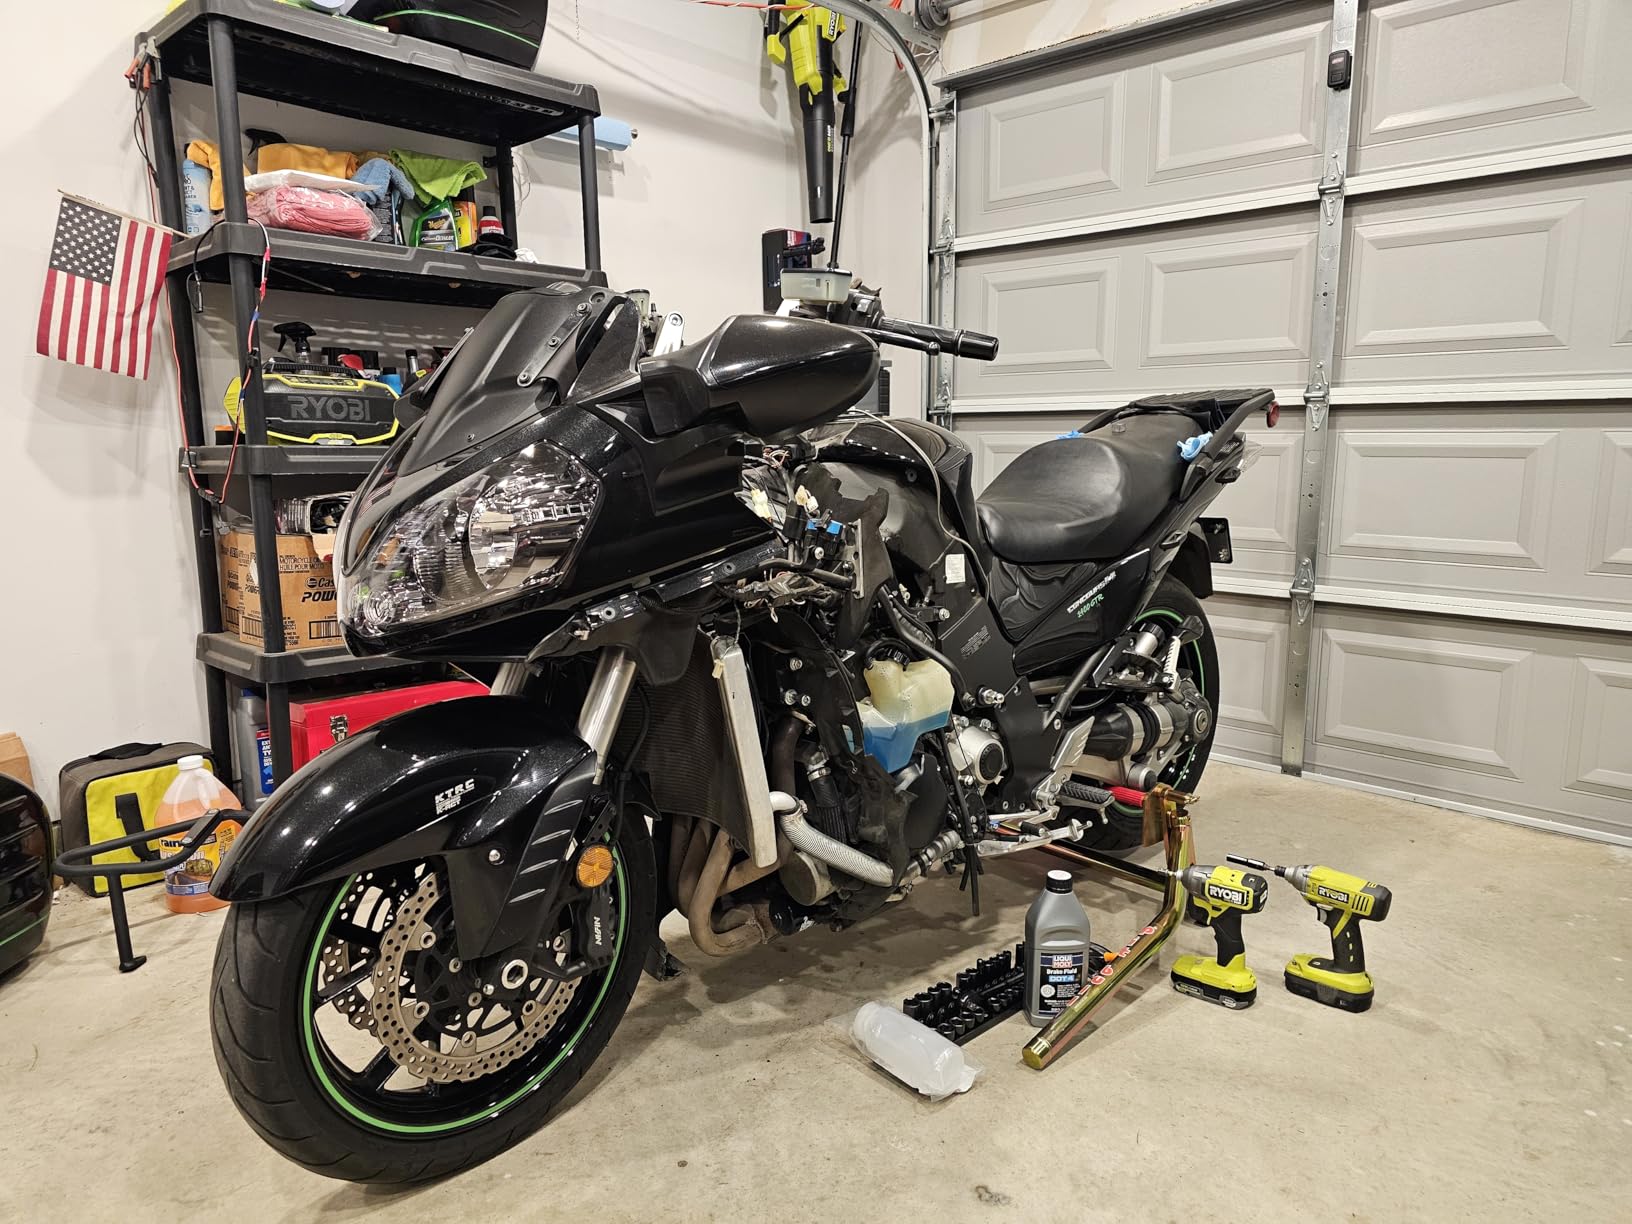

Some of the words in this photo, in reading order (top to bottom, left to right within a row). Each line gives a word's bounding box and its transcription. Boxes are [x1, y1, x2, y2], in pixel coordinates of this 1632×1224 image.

[288, 395, 371, 421] RYOBI
[318, 577, 335, 588] Cas
[301, 590, 337, 603] POW
[435, 778, 475, 804] KTRC
[1209, 885, 1242, 903] RYOBI
[1318, 886, 1348, 902] RYOBI
